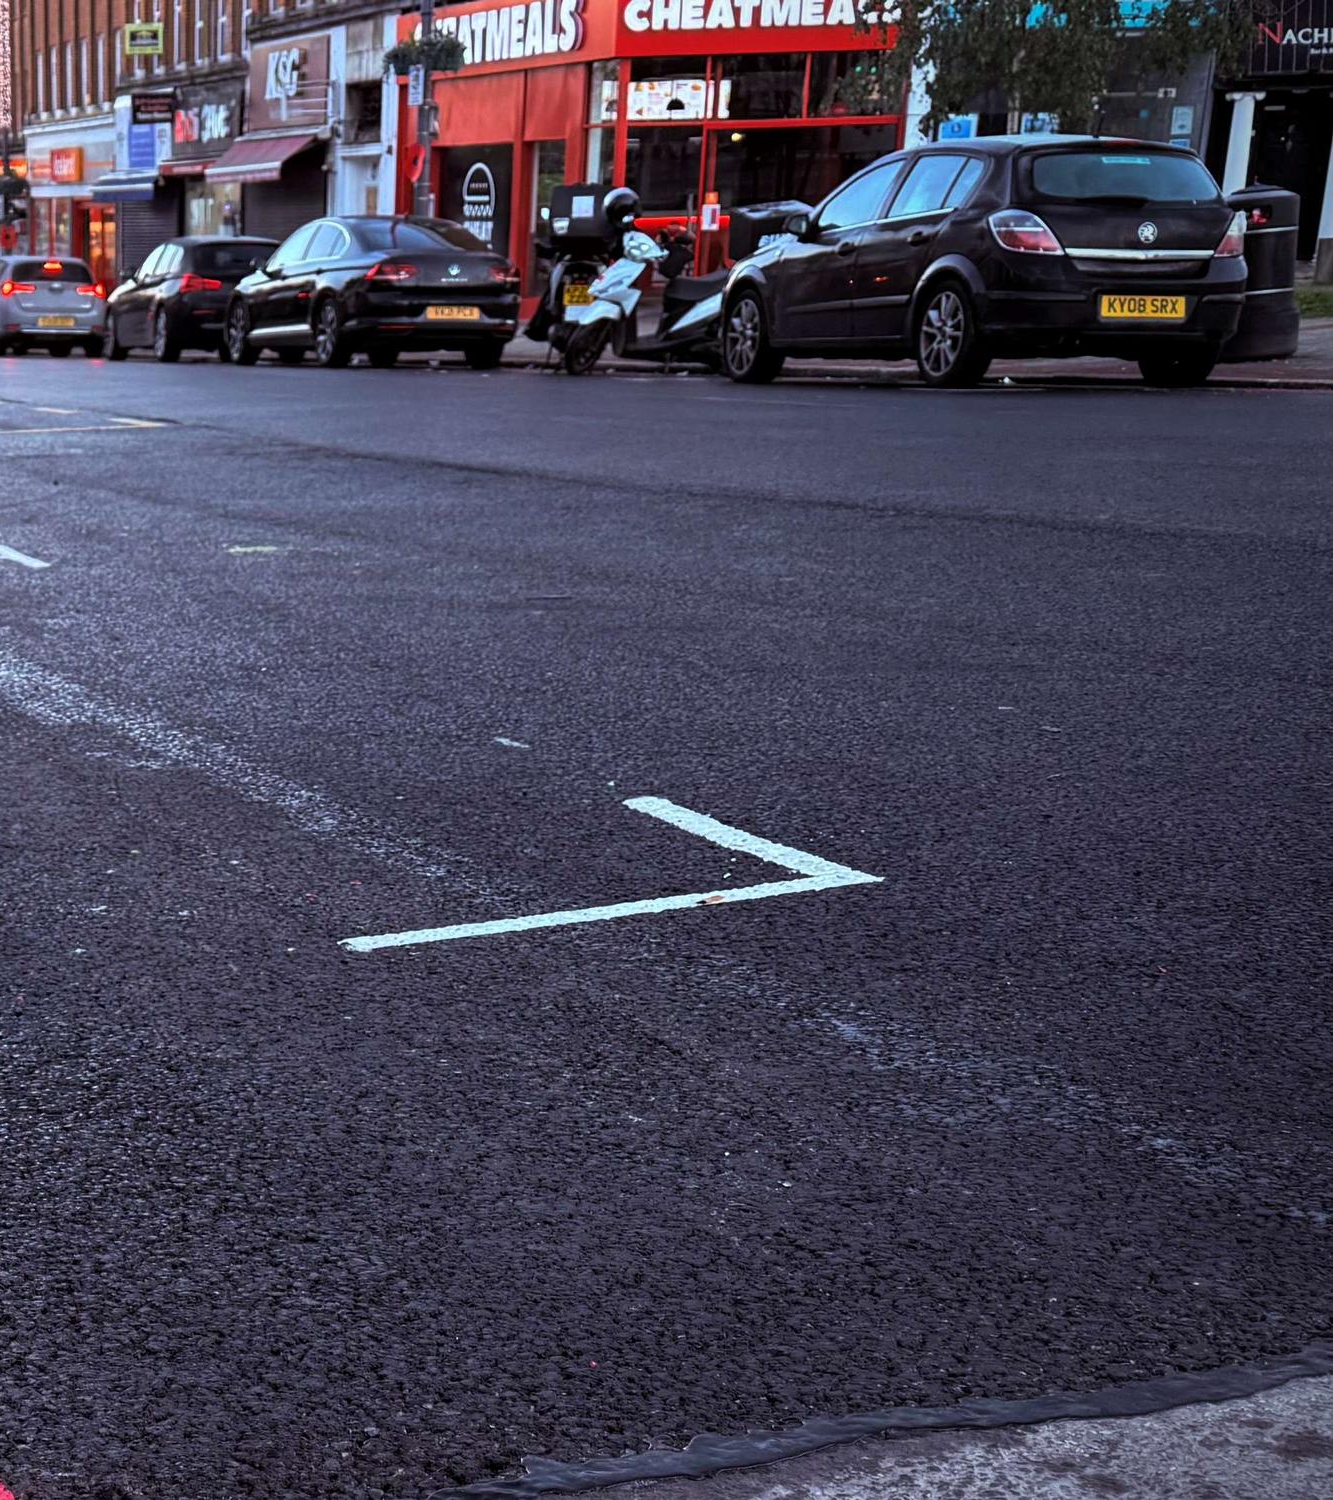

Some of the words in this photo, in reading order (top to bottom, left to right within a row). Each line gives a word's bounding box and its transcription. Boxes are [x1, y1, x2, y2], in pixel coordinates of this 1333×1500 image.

[413, 0, 576, 64] ATMEALS
[1107, 297, 1147, 313] KY08
[1150, 298, 1179, 314] SRX
